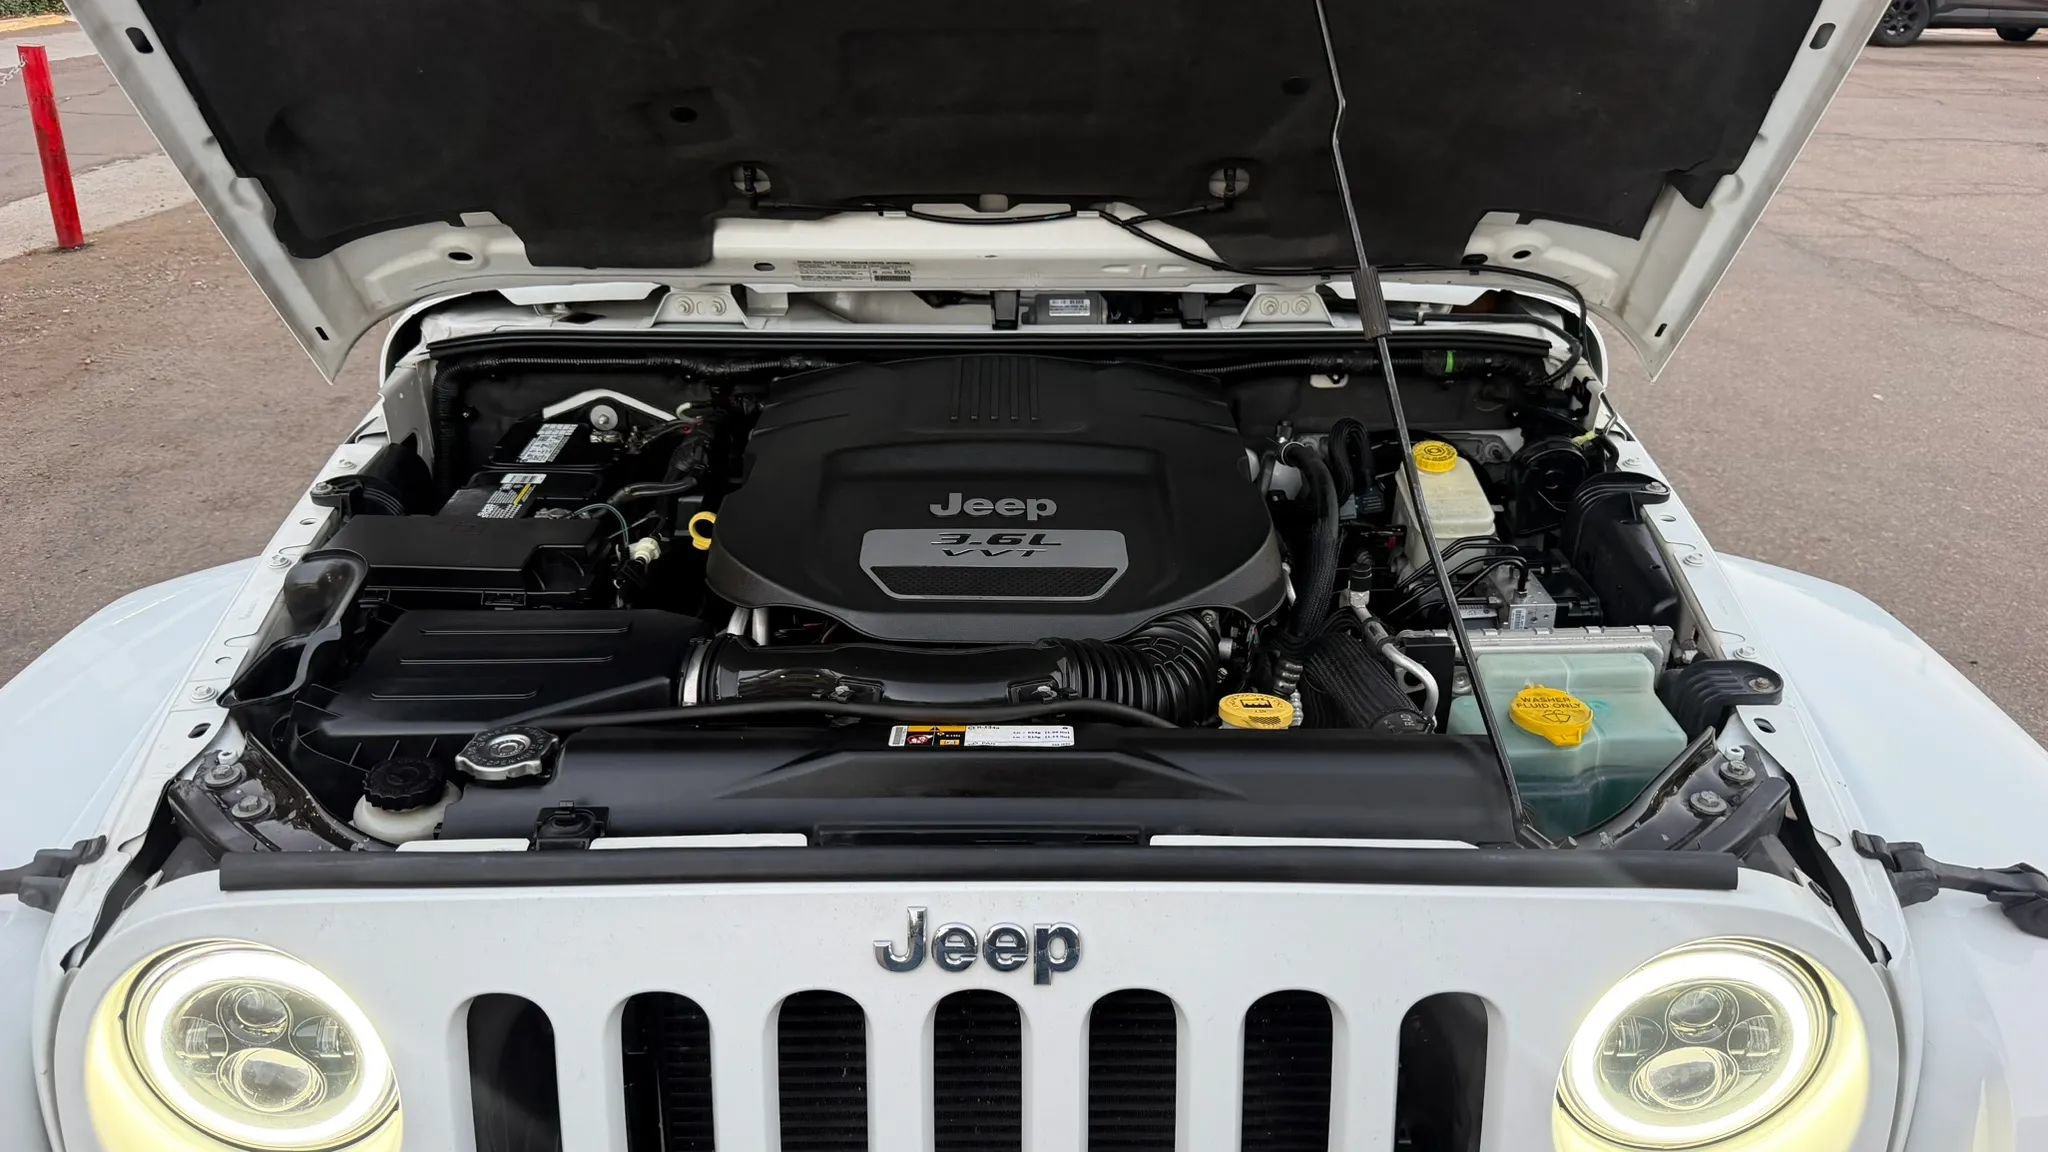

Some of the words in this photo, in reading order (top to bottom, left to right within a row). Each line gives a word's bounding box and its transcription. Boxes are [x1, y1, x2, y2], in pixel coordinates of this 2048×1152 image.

[929, 492, 1057, 521] Jeep
[930, 533, 1062, 546] 3.6L
[873, 906, 1082, 986] Jeep
